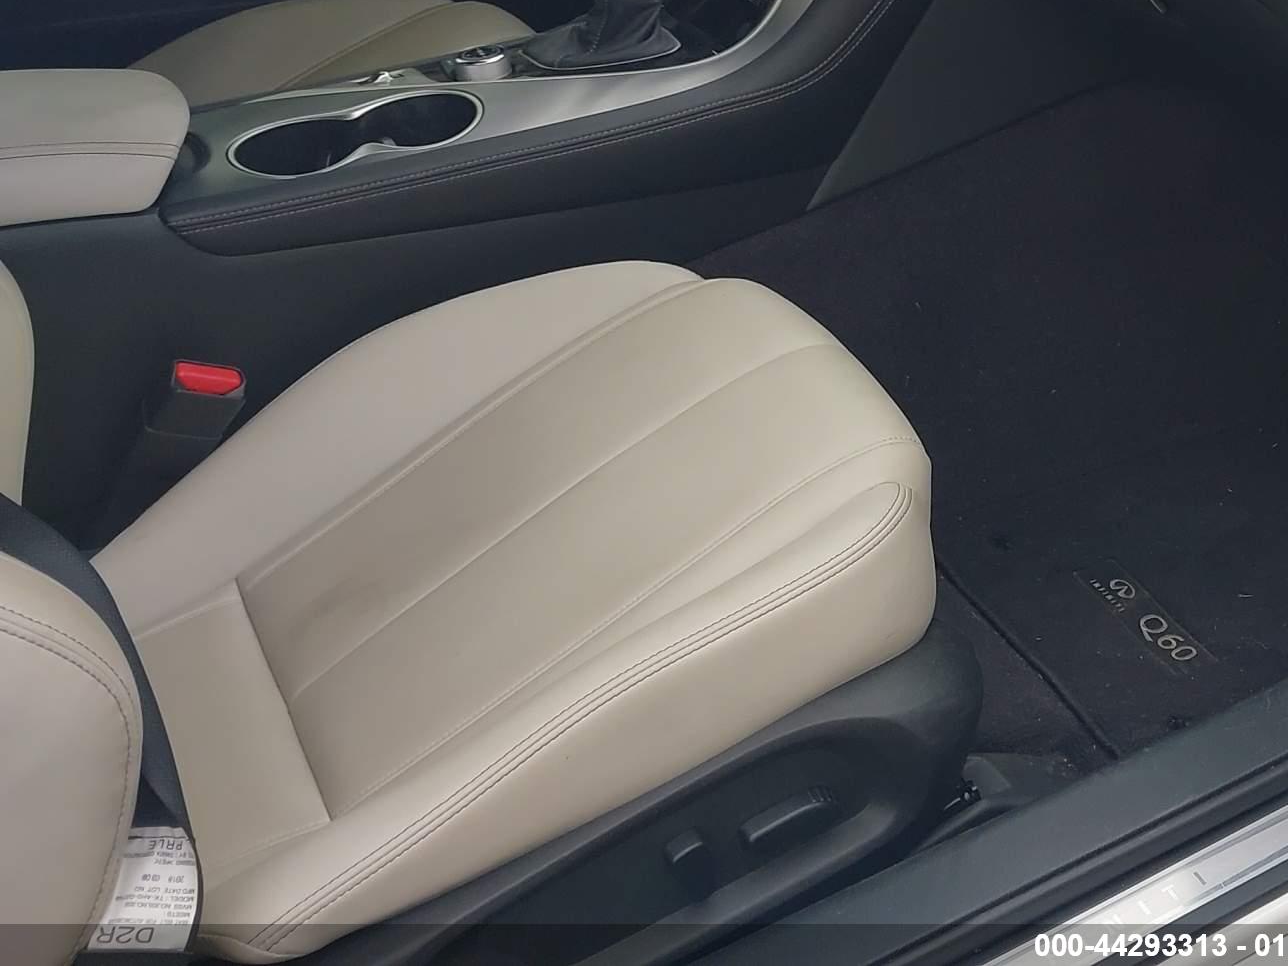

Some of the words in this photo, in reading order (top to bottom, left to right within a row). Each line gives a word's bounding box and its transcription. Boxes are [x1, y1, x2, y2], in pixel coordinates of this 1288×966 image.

[1139, 614, 1198, 661] Q60
[148, 839, 184, 851] PRLE
[96, 926, 154, 944] D2R
